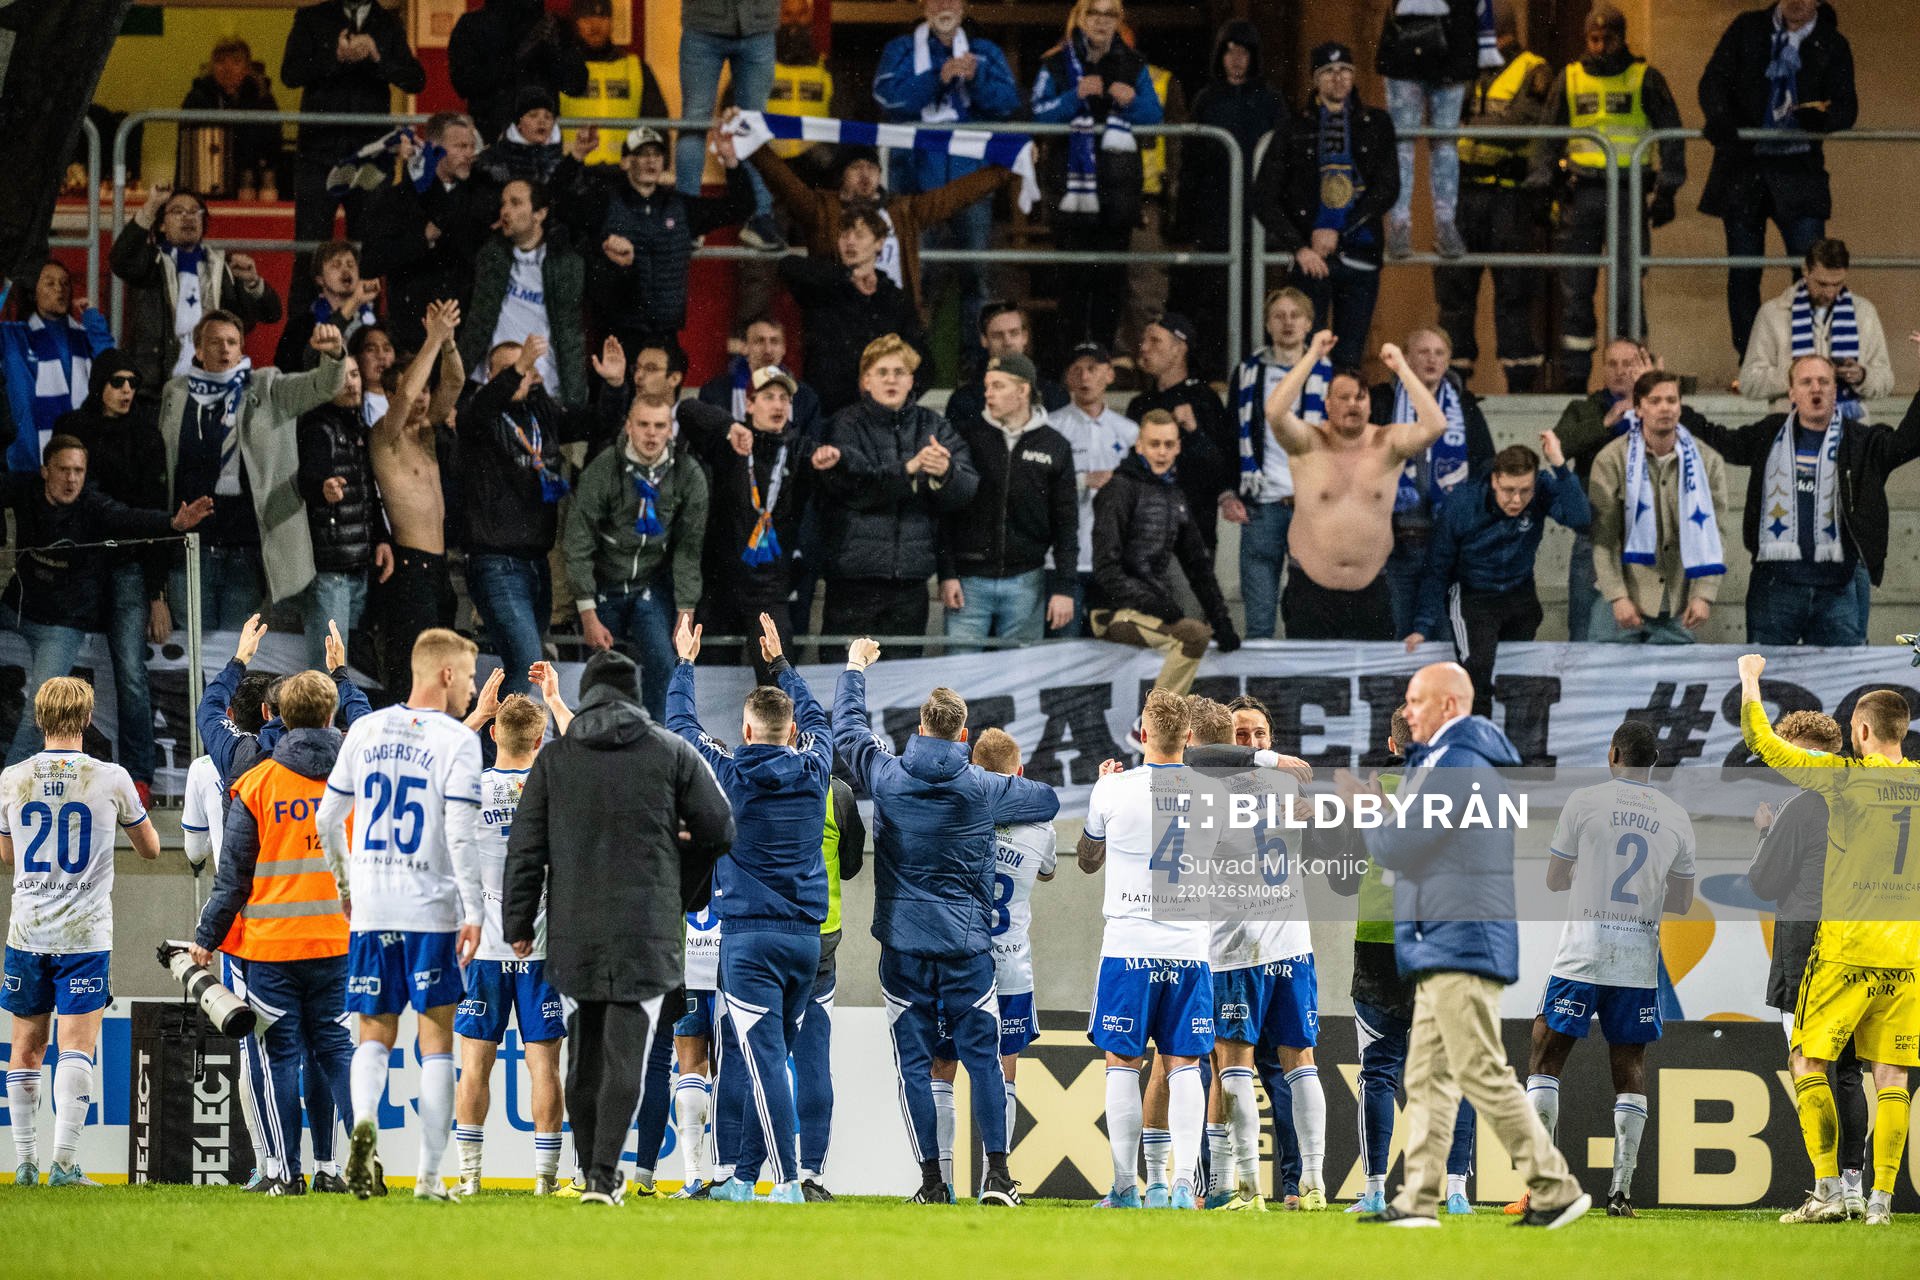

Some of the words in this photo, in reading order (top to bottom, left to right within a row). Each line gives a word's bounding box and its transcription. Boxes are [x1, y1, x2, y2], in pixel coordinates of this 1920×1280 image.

[1022, 450, 1053, 465] NASA
[34, 772, 78, 780] Norrköping
[44, 781, 64, 796] EID
[1150, 786, 1193, 796] Norrköping
[1156, 797, 1190, 813] LUND
[364, 771, 428, 855] 25
[1612, 811, 1660, 834] EKPOLO
[21, 801, 92, 875] 20
[1892, 806, 1911, 875] 1
[1149, 815, 1187, 884] 4
[1610, 832, 1649, 906] 2
[1149, 969, 1179, 985] RÖR
[70, 978, 90, 987] pre
[70, 986, 96, 994] zero
[542, 1002, 558, 1011] pre
[1221, 1004, 1234, 1012] pre
[1554, 1005, 1574, 1016] zero
[1103, 1015, 1117, 1025] pre
[1221, 1011, 1241, 1019] zero
[1002, 1018, 1020, 1027] pre
[1192, 1018, 1207, 1028] pre
[1003, 1026, 1026, 1034] zero
[1103, 1024, 1123, 1032] zero
